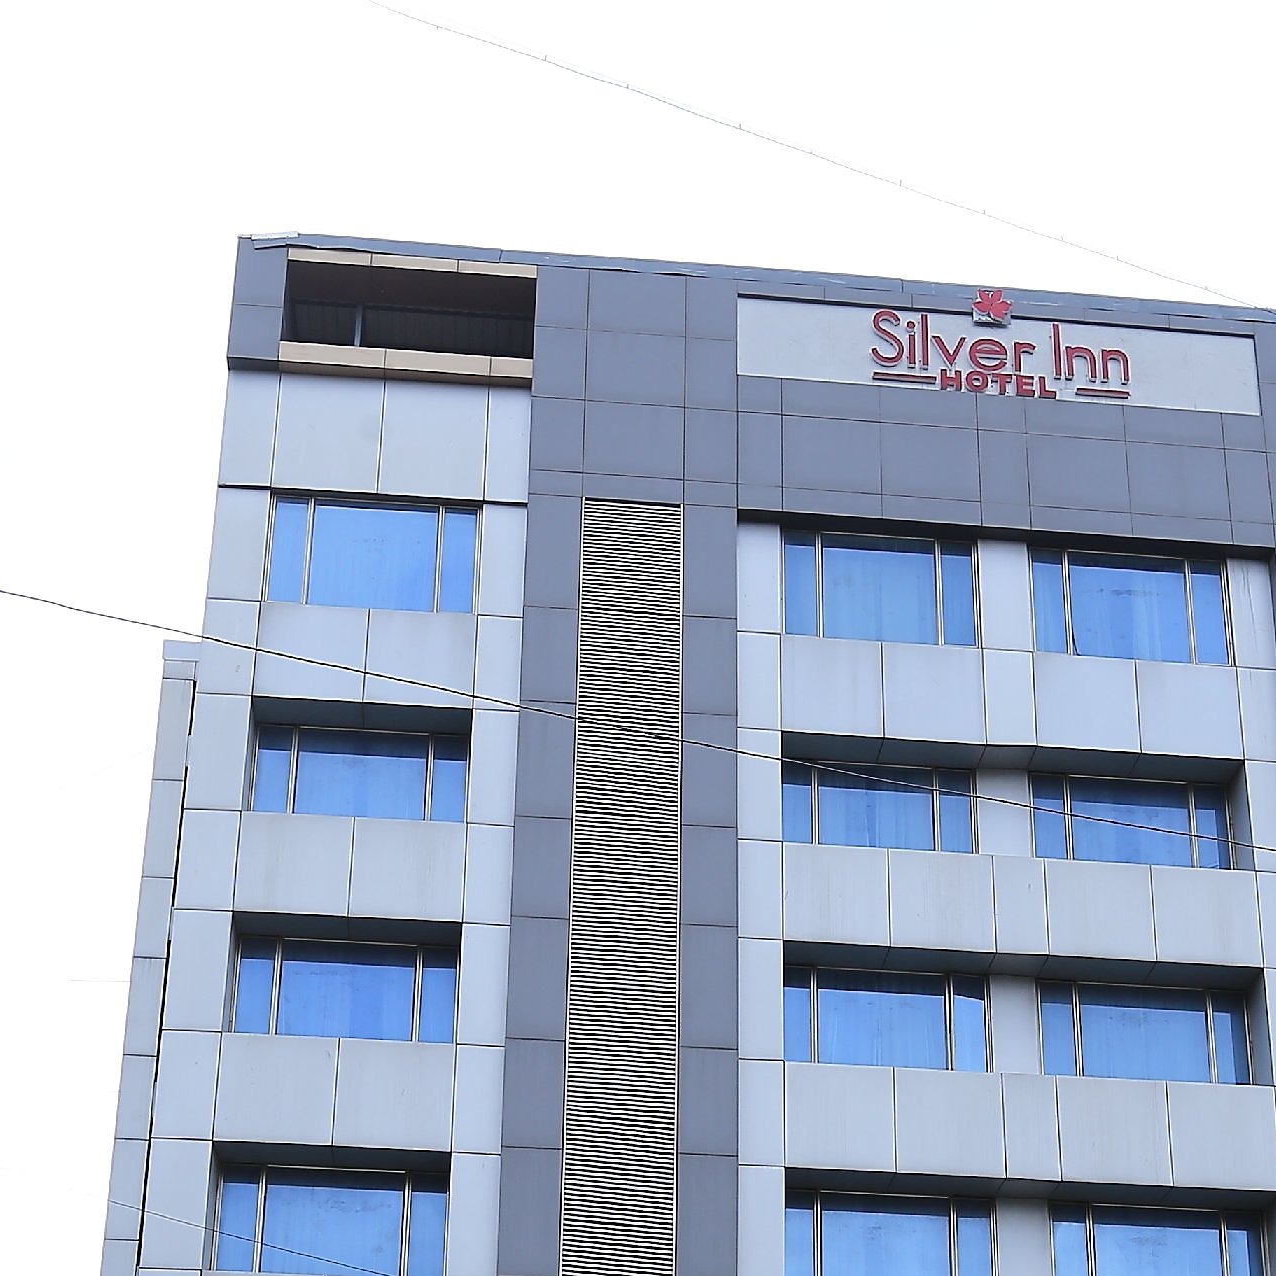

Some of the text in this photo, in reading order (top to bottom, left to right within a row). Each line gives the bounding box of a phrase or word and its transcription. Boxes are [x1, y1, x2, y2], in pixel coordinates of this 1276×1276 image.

[871, 309, 1130, 384] Silver Inn
[940, 368, 1057, 399] HOTEL
